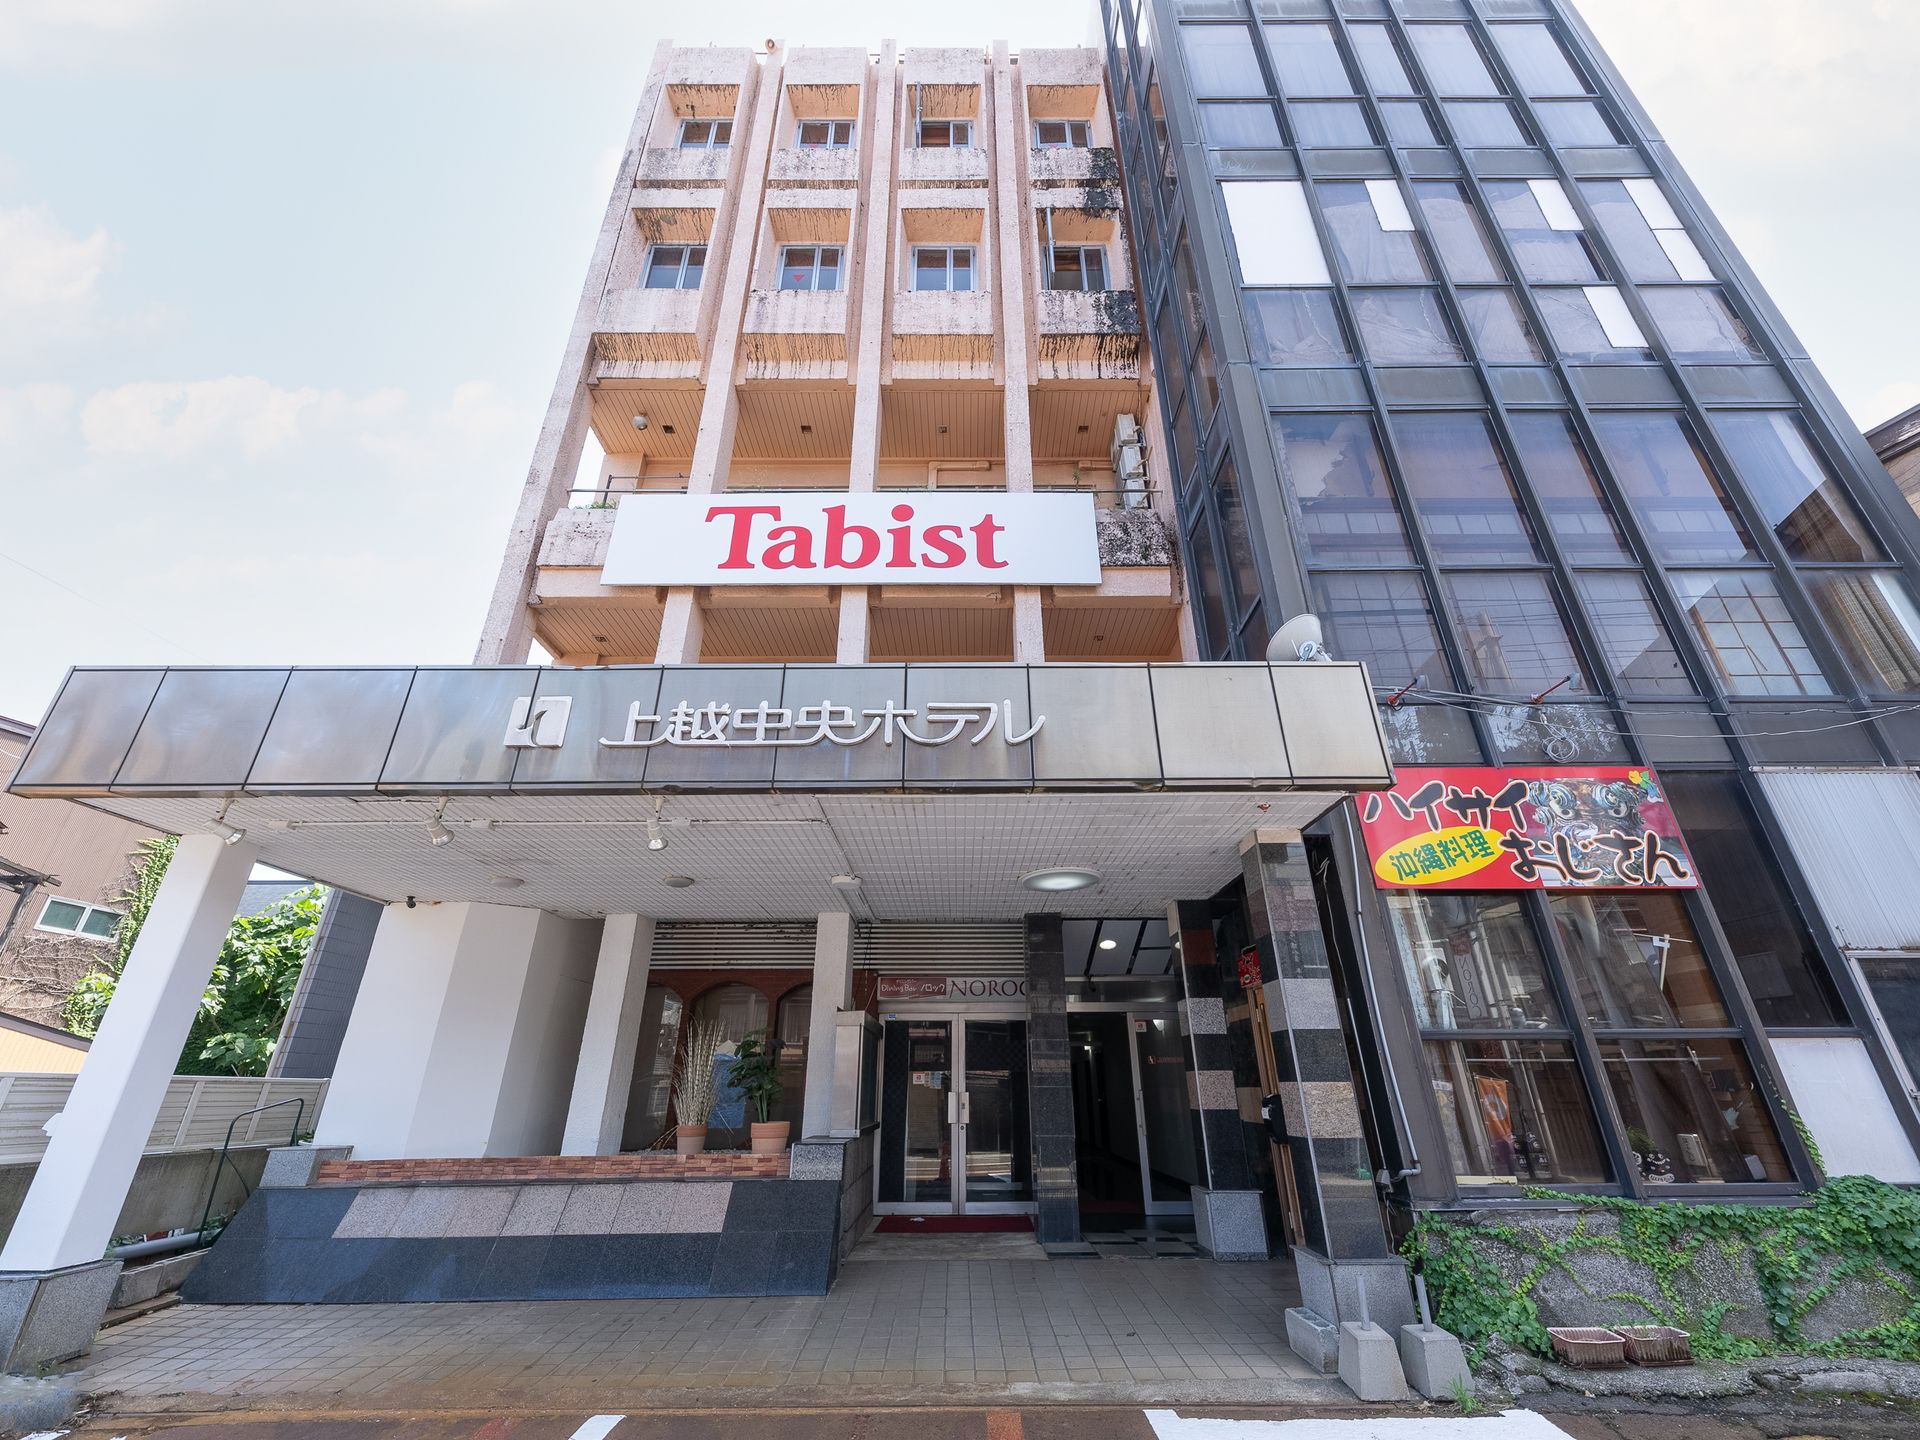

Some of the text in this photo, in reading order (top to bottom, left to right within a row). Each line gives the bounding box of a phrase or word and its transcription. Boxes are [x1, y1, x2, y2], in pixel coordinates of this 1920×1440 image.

[705, 504, 1009, 570] Tabist
[598, 698, 1046, 747] 上越中央ホテル
[1364, 779, 1530, 833] ハイサイ
[1389, 829, 1495, 881] 沖縄料理
[1498, 829, 1689, 885] おじさん
[881, 983, 945, 993] Dining Bar ノロック
